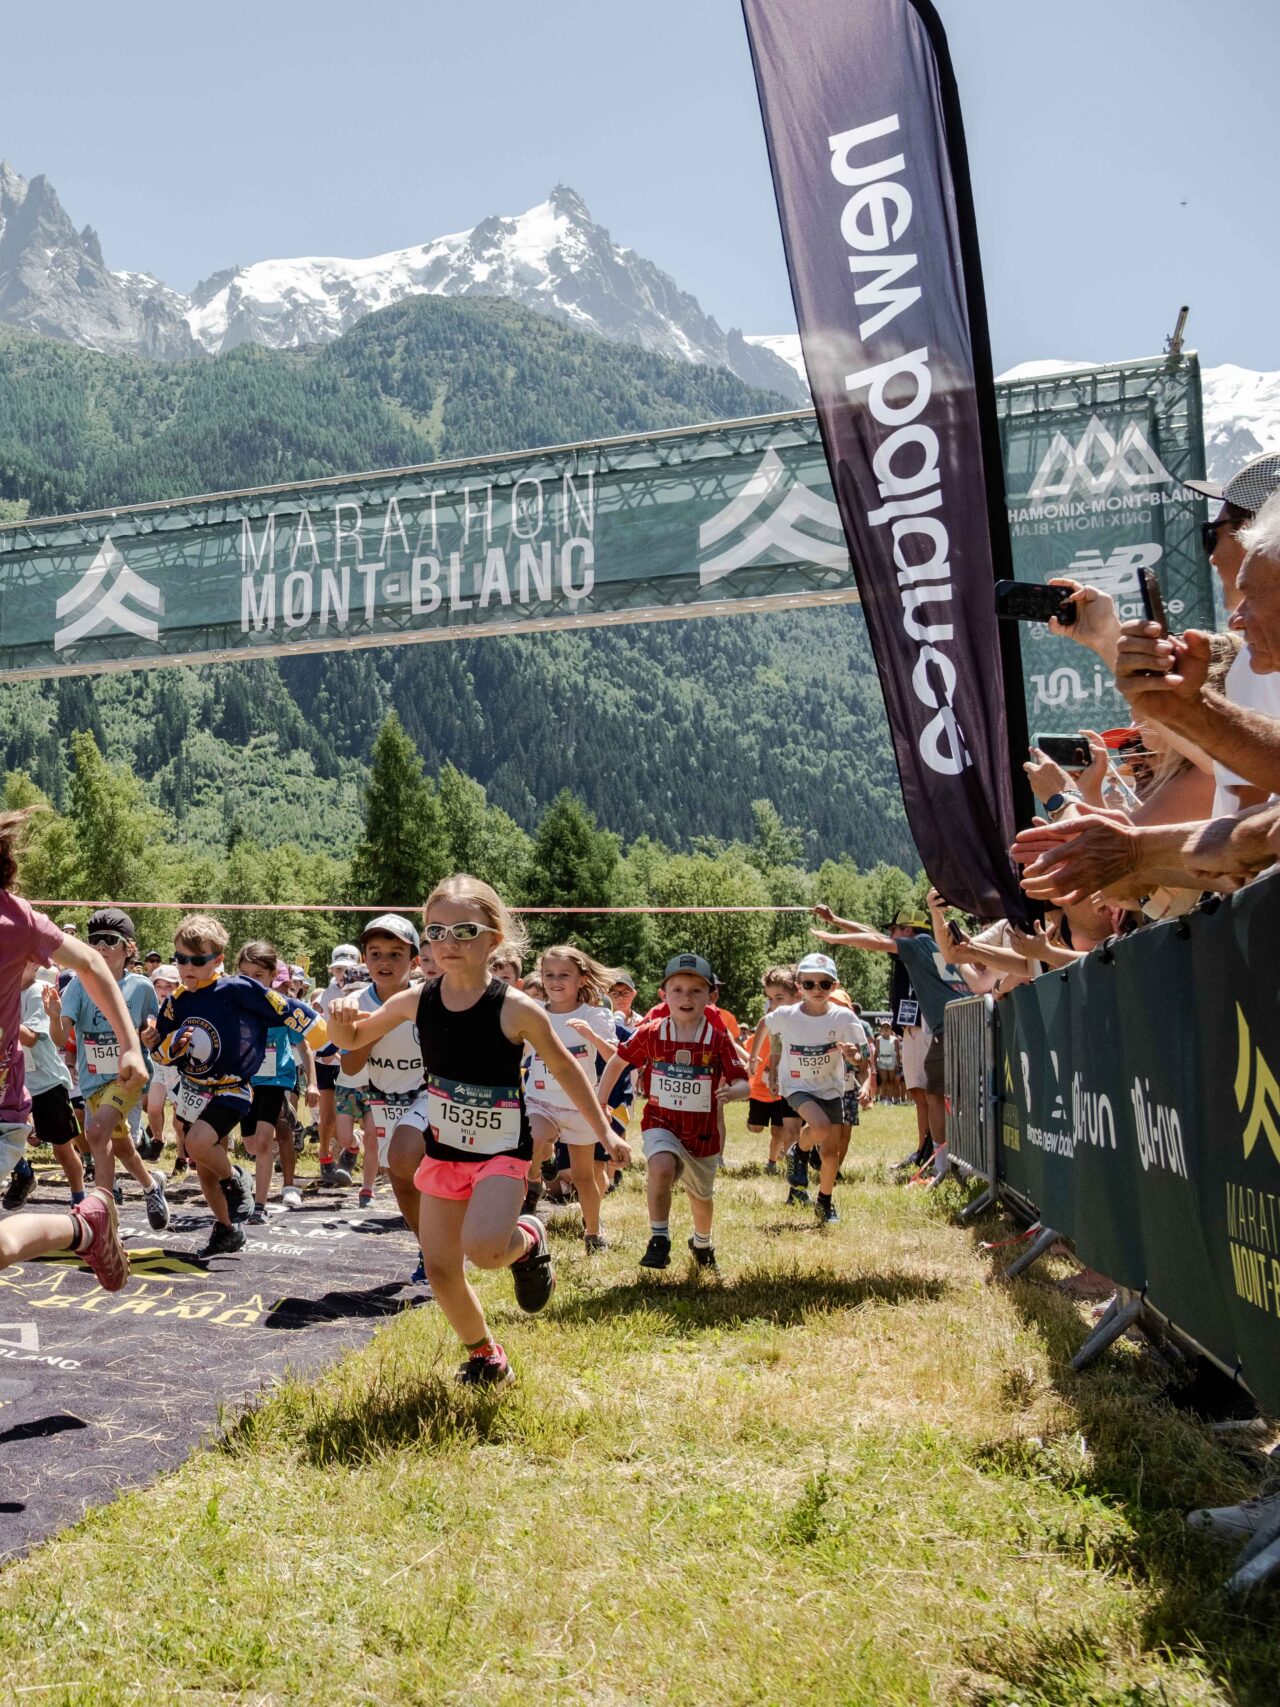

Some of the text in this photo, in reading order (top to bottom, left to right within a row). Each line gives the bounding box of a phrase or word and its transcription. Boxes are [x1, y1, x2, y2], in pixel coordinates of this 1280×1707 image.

[1007, 491, 1204, 523] HAMONIX-MONT-BLANC
[241, 470, 595, 572] MARATHON
[241, 537, 595, 633] MONT-BLANC
[283, 1007, 312, 1034] 22
[369, 1057, 422, 1070] MA CG
[797, 1054, 831, 1067] 15320
[182, 1090, 204, 1109] 369
[658, 1078, 701, 1095] 15380
[381, 1106, 410, 1121] 153
[440, 1102, 503, 1130] 15355
[460, 1127, 477, 1137] MILA
[1145, 1077, 1188, 1180] i-run
[1226, 1181, 1280, 1256] MARAT
